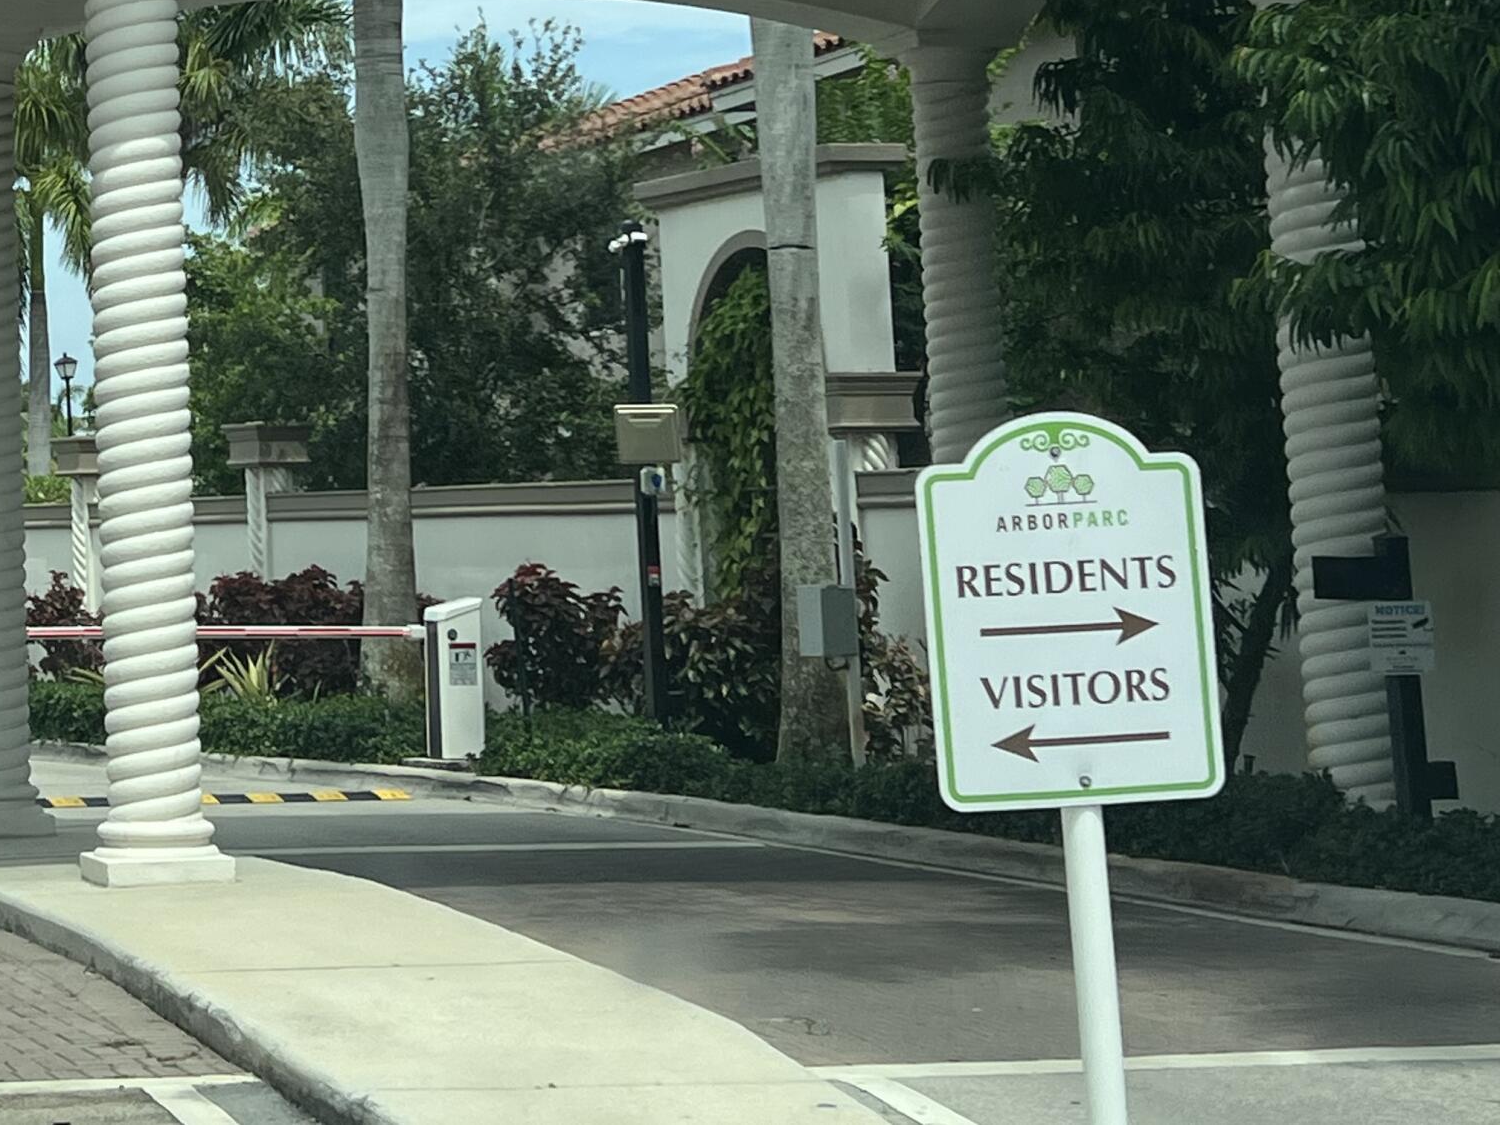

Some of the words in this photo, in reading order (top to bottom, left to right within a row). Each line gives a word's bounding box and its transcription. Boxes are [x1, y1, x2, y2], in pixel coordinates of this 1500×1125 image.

[996, 509, 1129, 533] ARBORPARC
[955, 554, 1177, 599] RESIDENTS
[980, 667, 1171, 710] VISITORS
